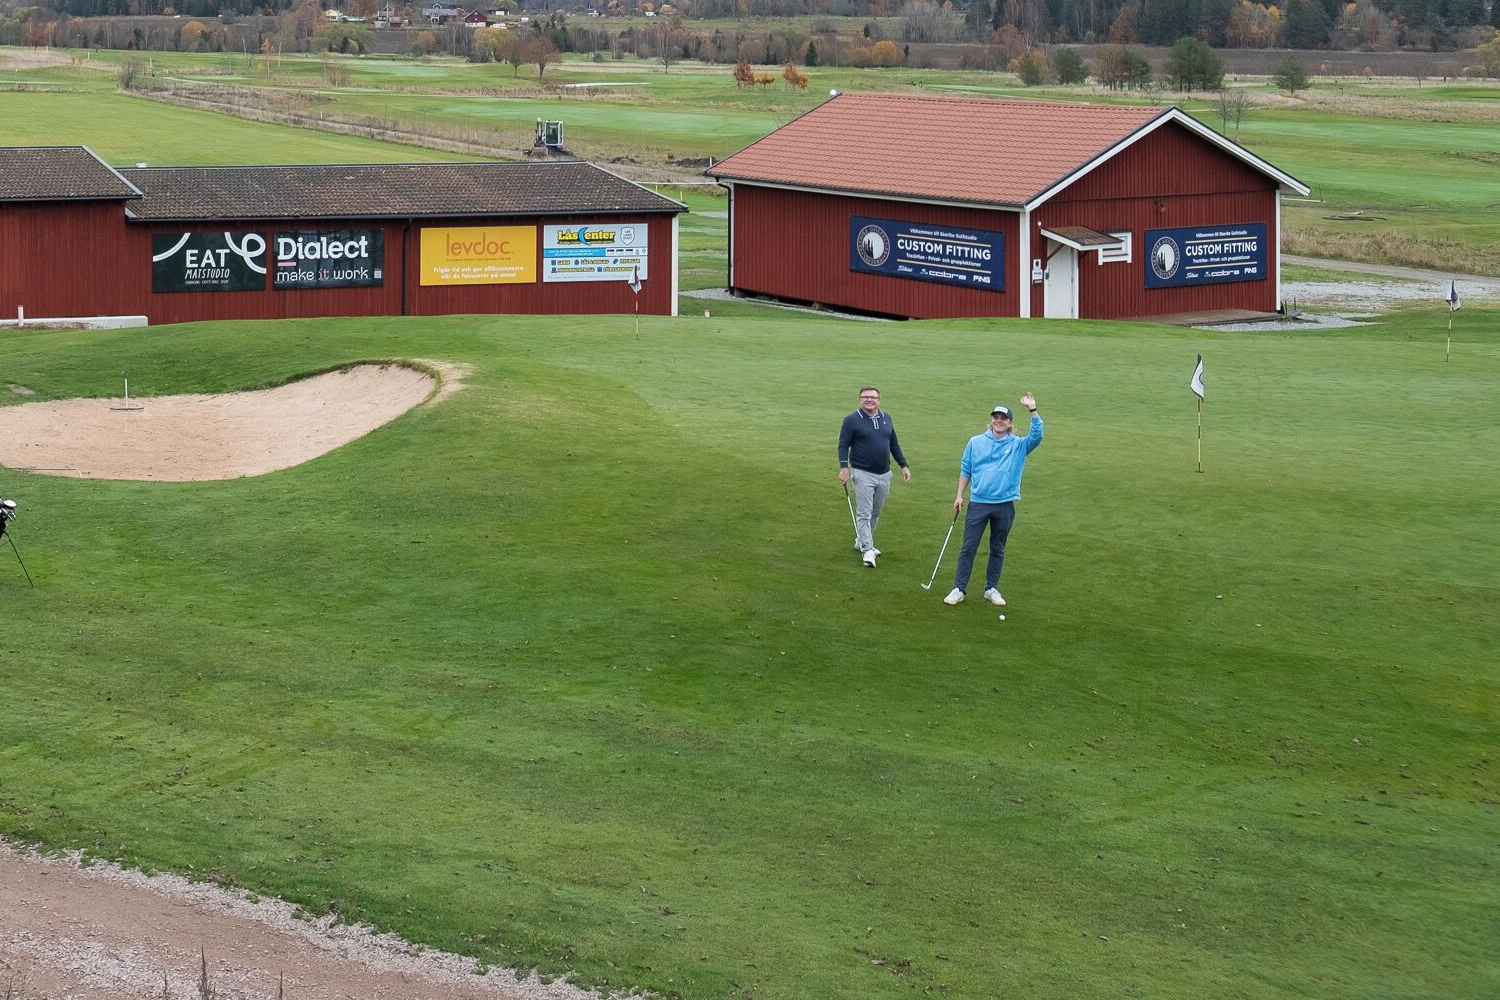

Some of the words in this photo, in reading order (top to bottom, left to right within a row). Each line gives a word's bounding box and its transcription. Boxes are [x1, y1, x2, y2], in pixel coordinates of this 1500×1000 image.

[277, 236, 368, 260] Dialect
[446, 232, 510, 257] levdoc
[897, 239, 943, 255] CUSTOM
[946, 244, 991, 260] FITTING
[1185, 243, 1221, 256] CUSTOM
[1224, 241, 1257, 254] FITTING
[186, 249, 230, 268] EAT
[185, 268, 230, 279] MATSTUDIO
[277, 269, 315, 282] make
[318, 269, 329, 281] it
[333, 267, 368, 280] work
[929, 270, 966, 280] cobra
[973, 275, 991, 284] PING
